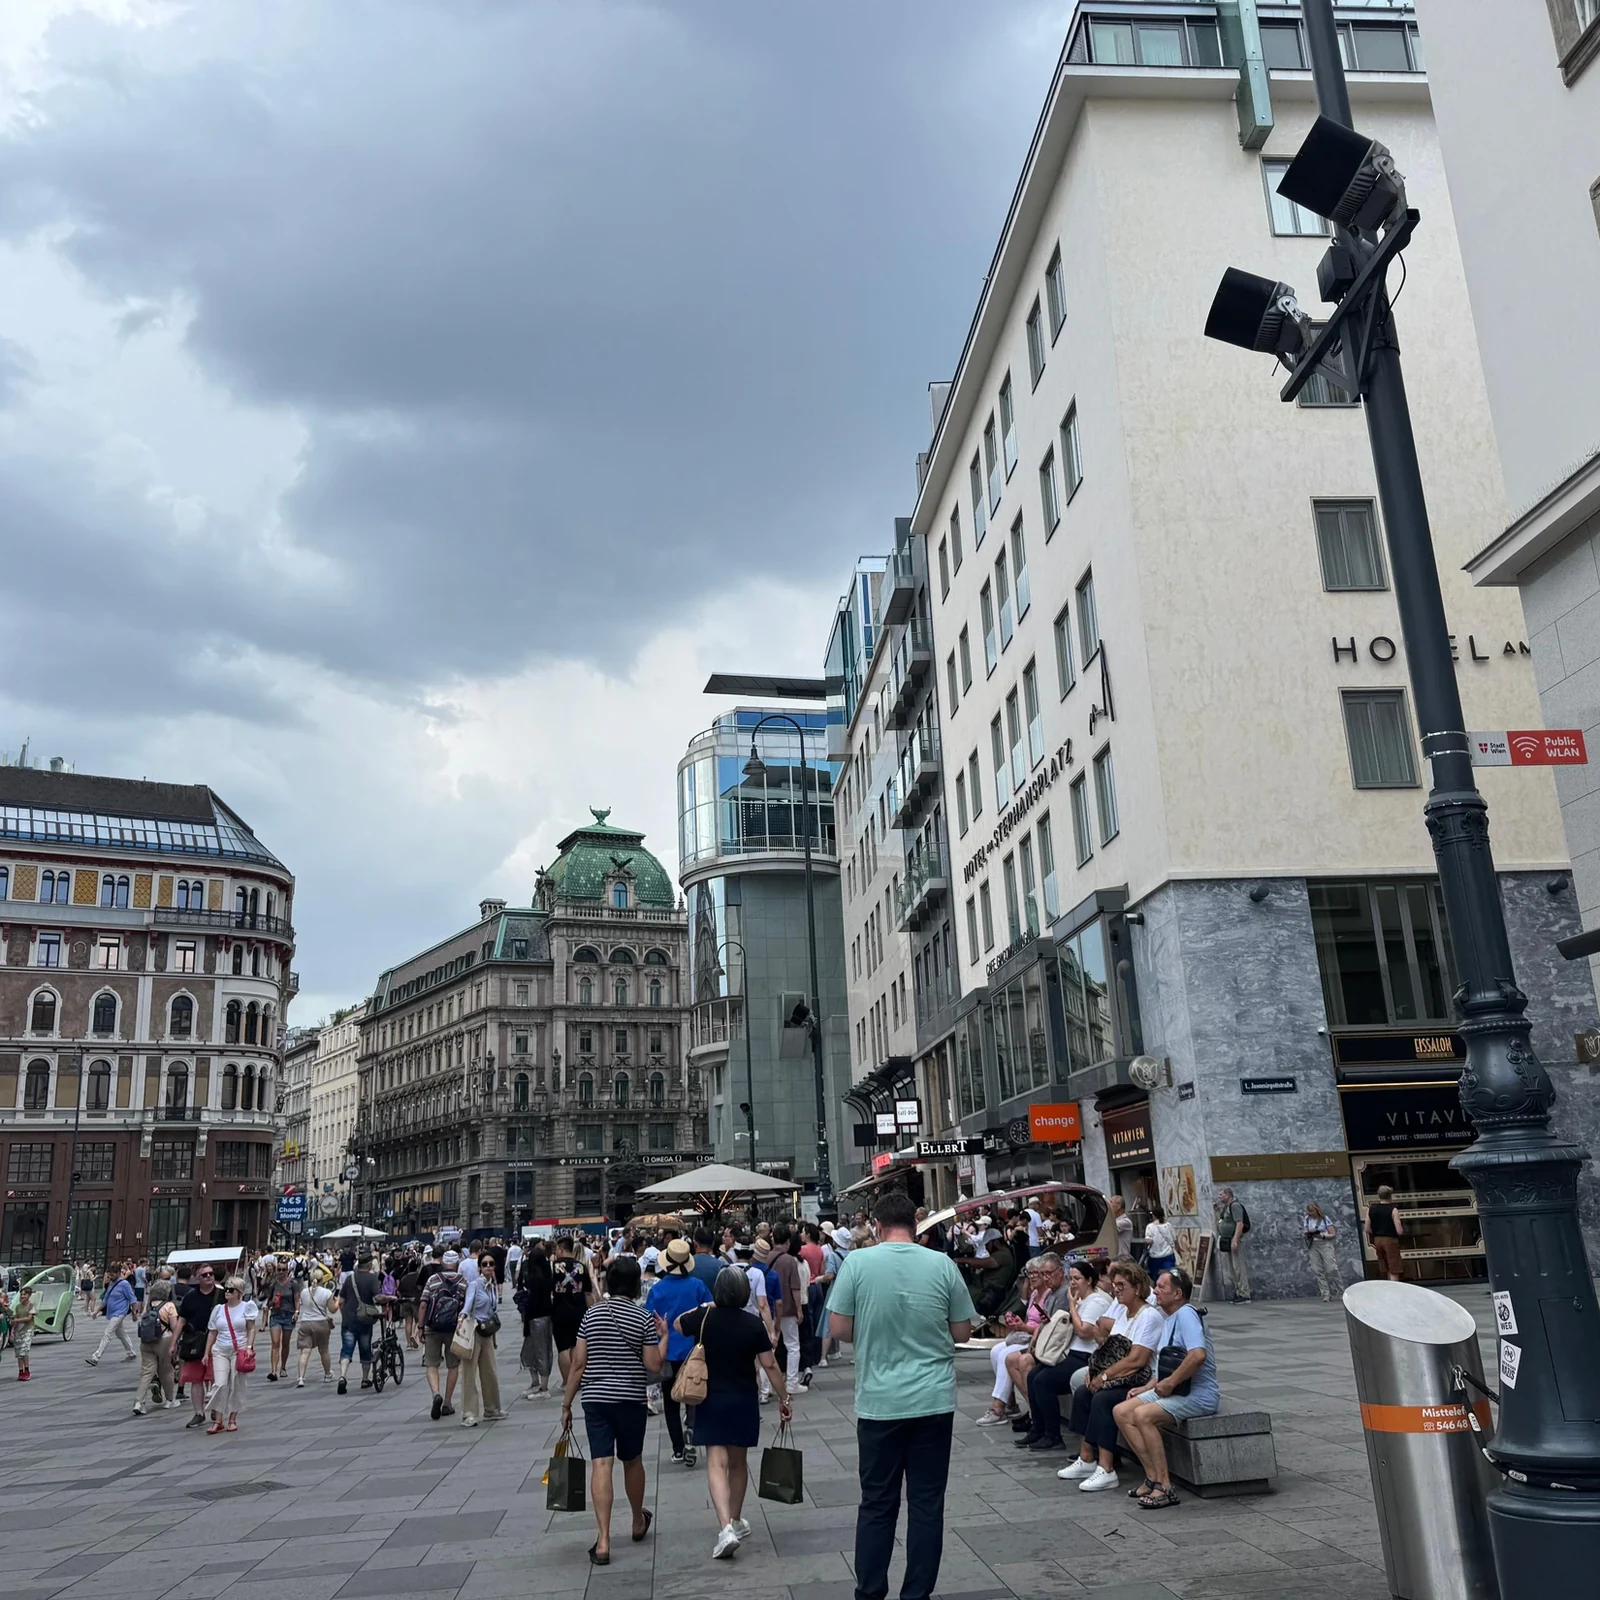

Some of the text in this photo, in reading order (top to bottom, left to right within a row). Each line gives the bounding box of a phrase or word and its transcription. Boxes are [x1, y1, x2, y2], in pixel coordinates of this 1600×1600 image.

[1331, 635, 1490, 663] HOEL
[1544, 737, 1576, 746] Public
[1546, 748, 1580, 757] WLAN
[963, 846, 988, 884] HOTEL
[993, 738, 1074, 848] STEPHANSPLATZ
[1414, 1037, 1453, 1053] EISSALON
[1035, 1116, 1075, 1128] change
[1386, 1109, 1467, 1126] VITAVI
[1112, 1127, 1145, 1145] VITAVIEN
[1500, 1321, 1513, 1330] WEG
[1422, 1406, 1466, 1418] Misttelef
[1437, 1420, 1468, 1430] 546 48
